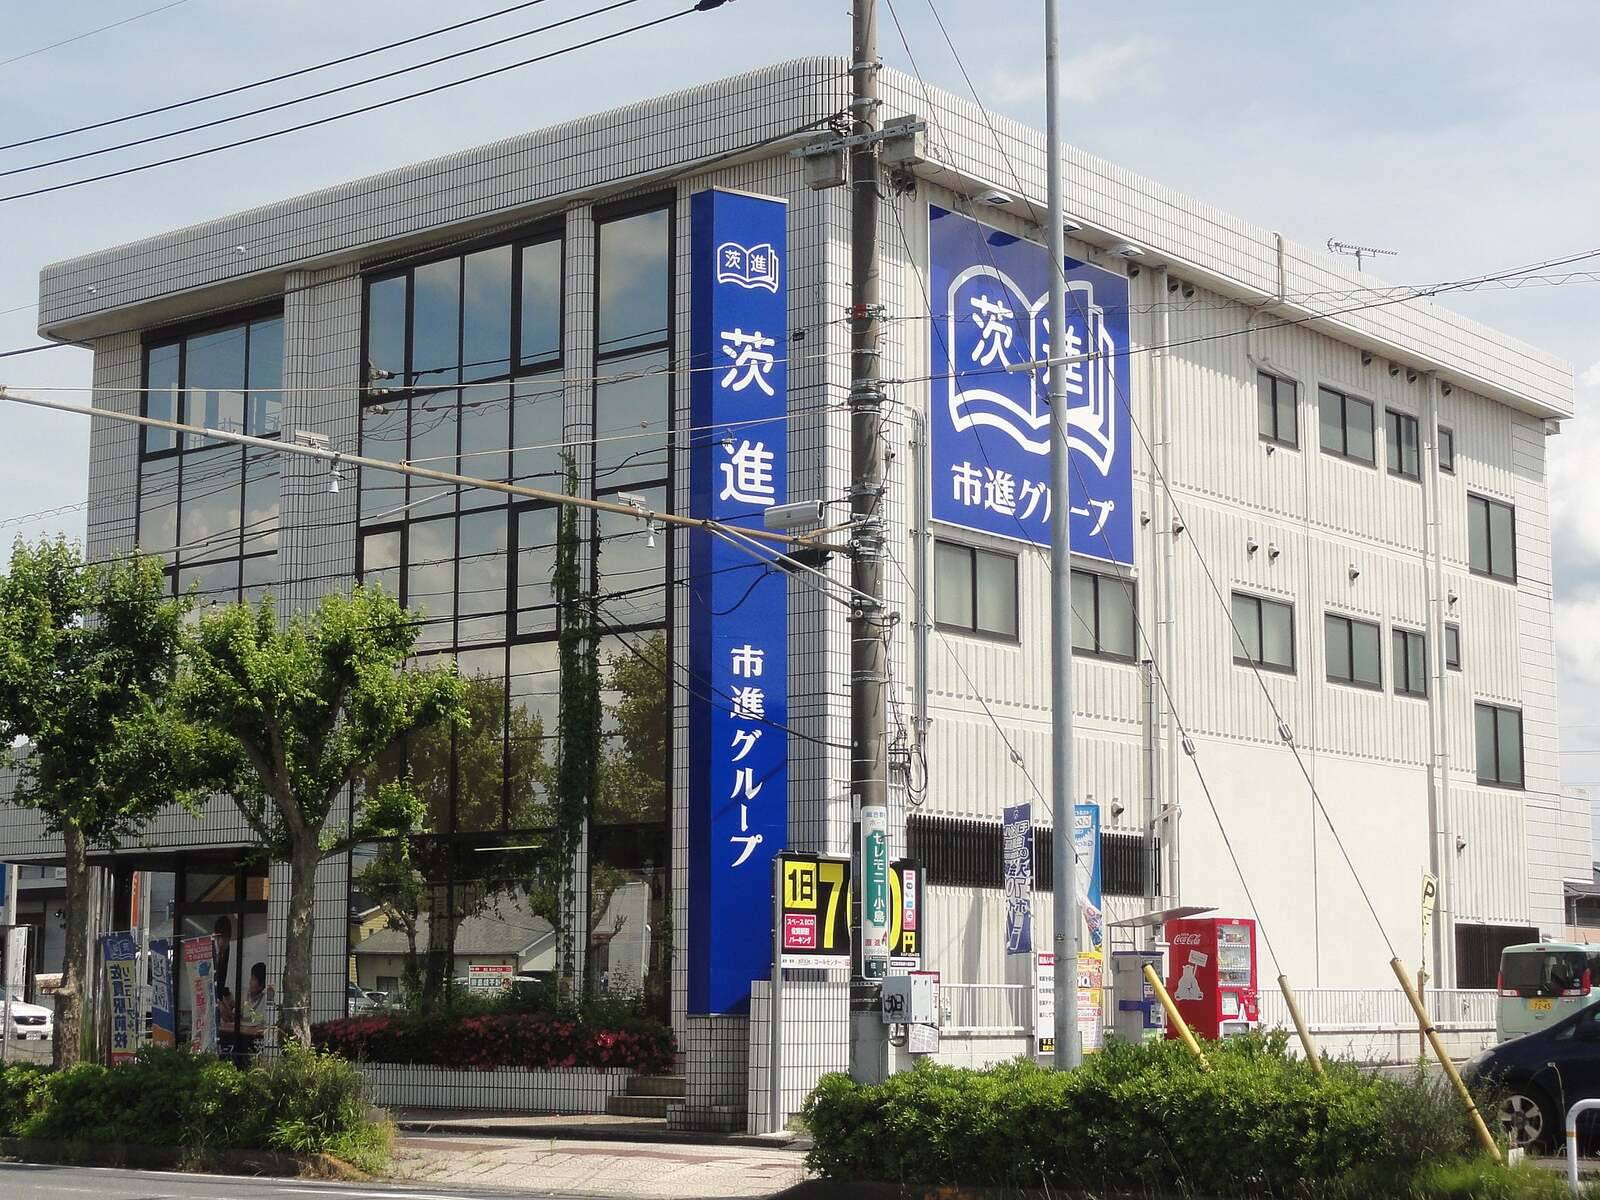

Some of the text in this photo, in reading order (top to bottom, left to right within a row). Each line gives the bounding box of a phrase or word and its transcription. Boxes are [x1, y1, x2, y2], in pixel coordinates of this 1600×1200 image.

[724, 249, 767, 273] 茨進
[720, 327, 775, 506] 茨進
[730, 644, 765, 868] 市進グループ
[788, 869, 814, 902] 1日
[873, 832, 886, 923] セレモニー小島
[902, 931, 916, 953] 円
